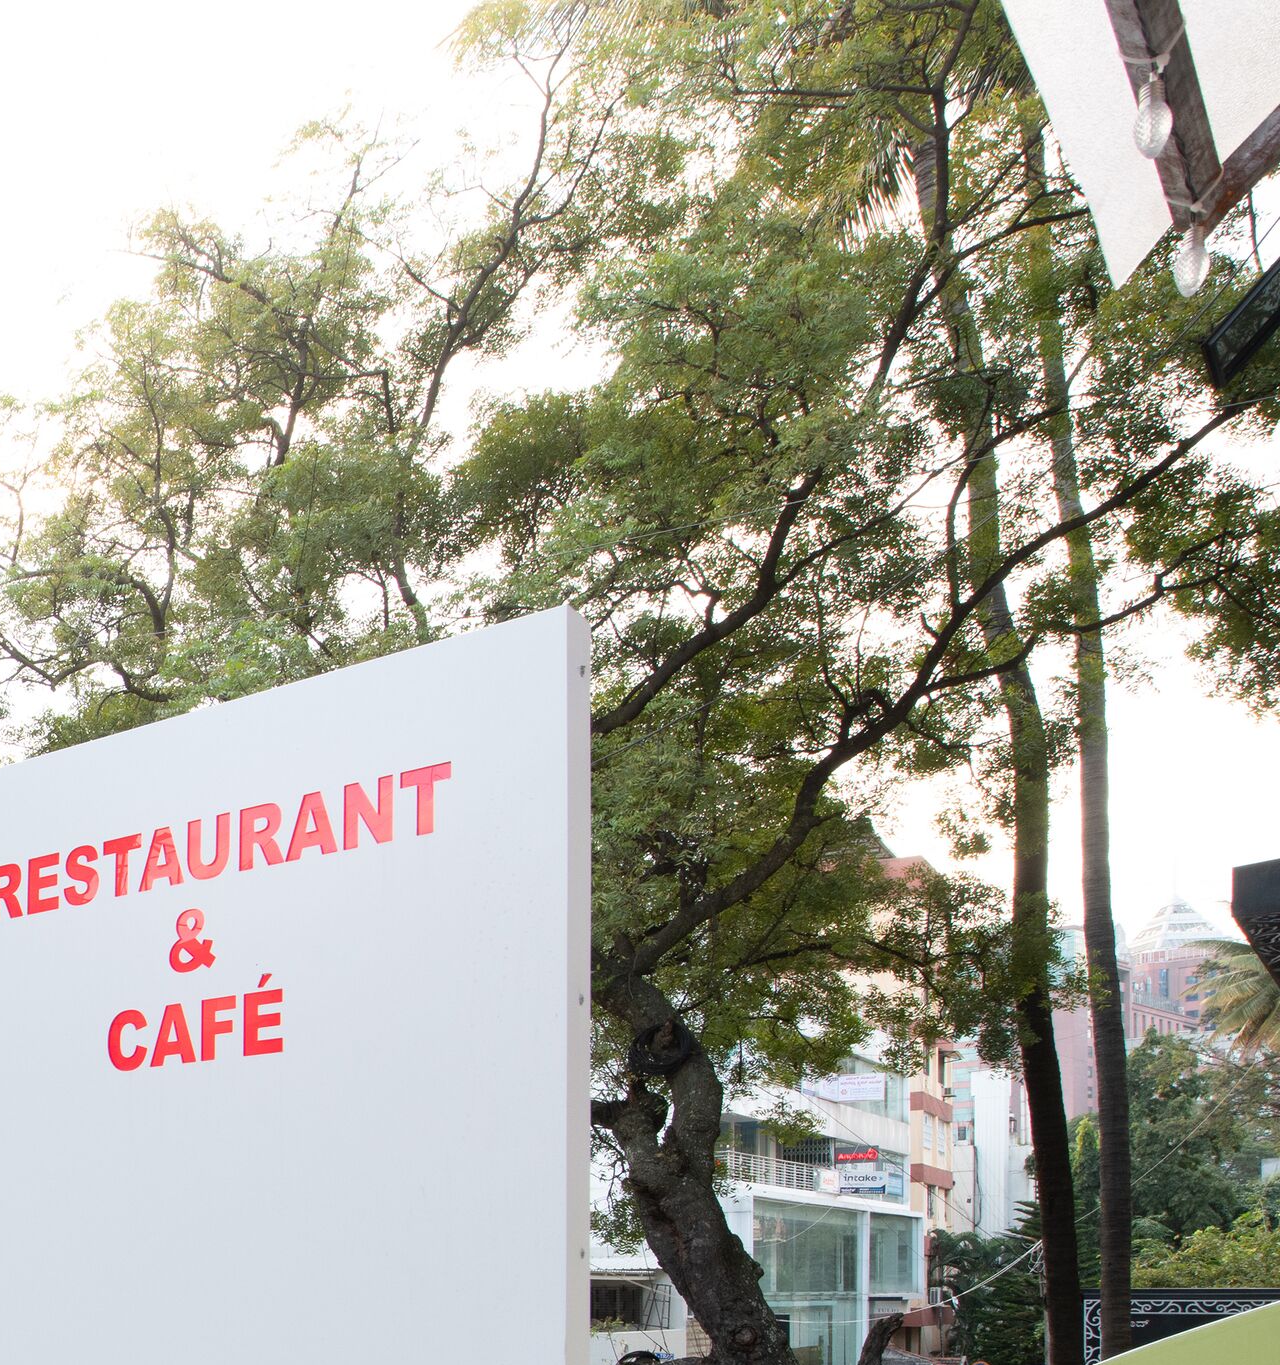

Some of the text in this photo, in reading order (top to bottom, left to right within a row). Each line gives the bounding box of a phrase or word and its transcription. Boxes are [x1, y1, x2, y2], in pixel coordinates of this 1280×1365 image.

[168, 908, 217, 974] &
[107, 973, 284, 1072] CAFÉ
[843, 1173, 878, 1182] intake
